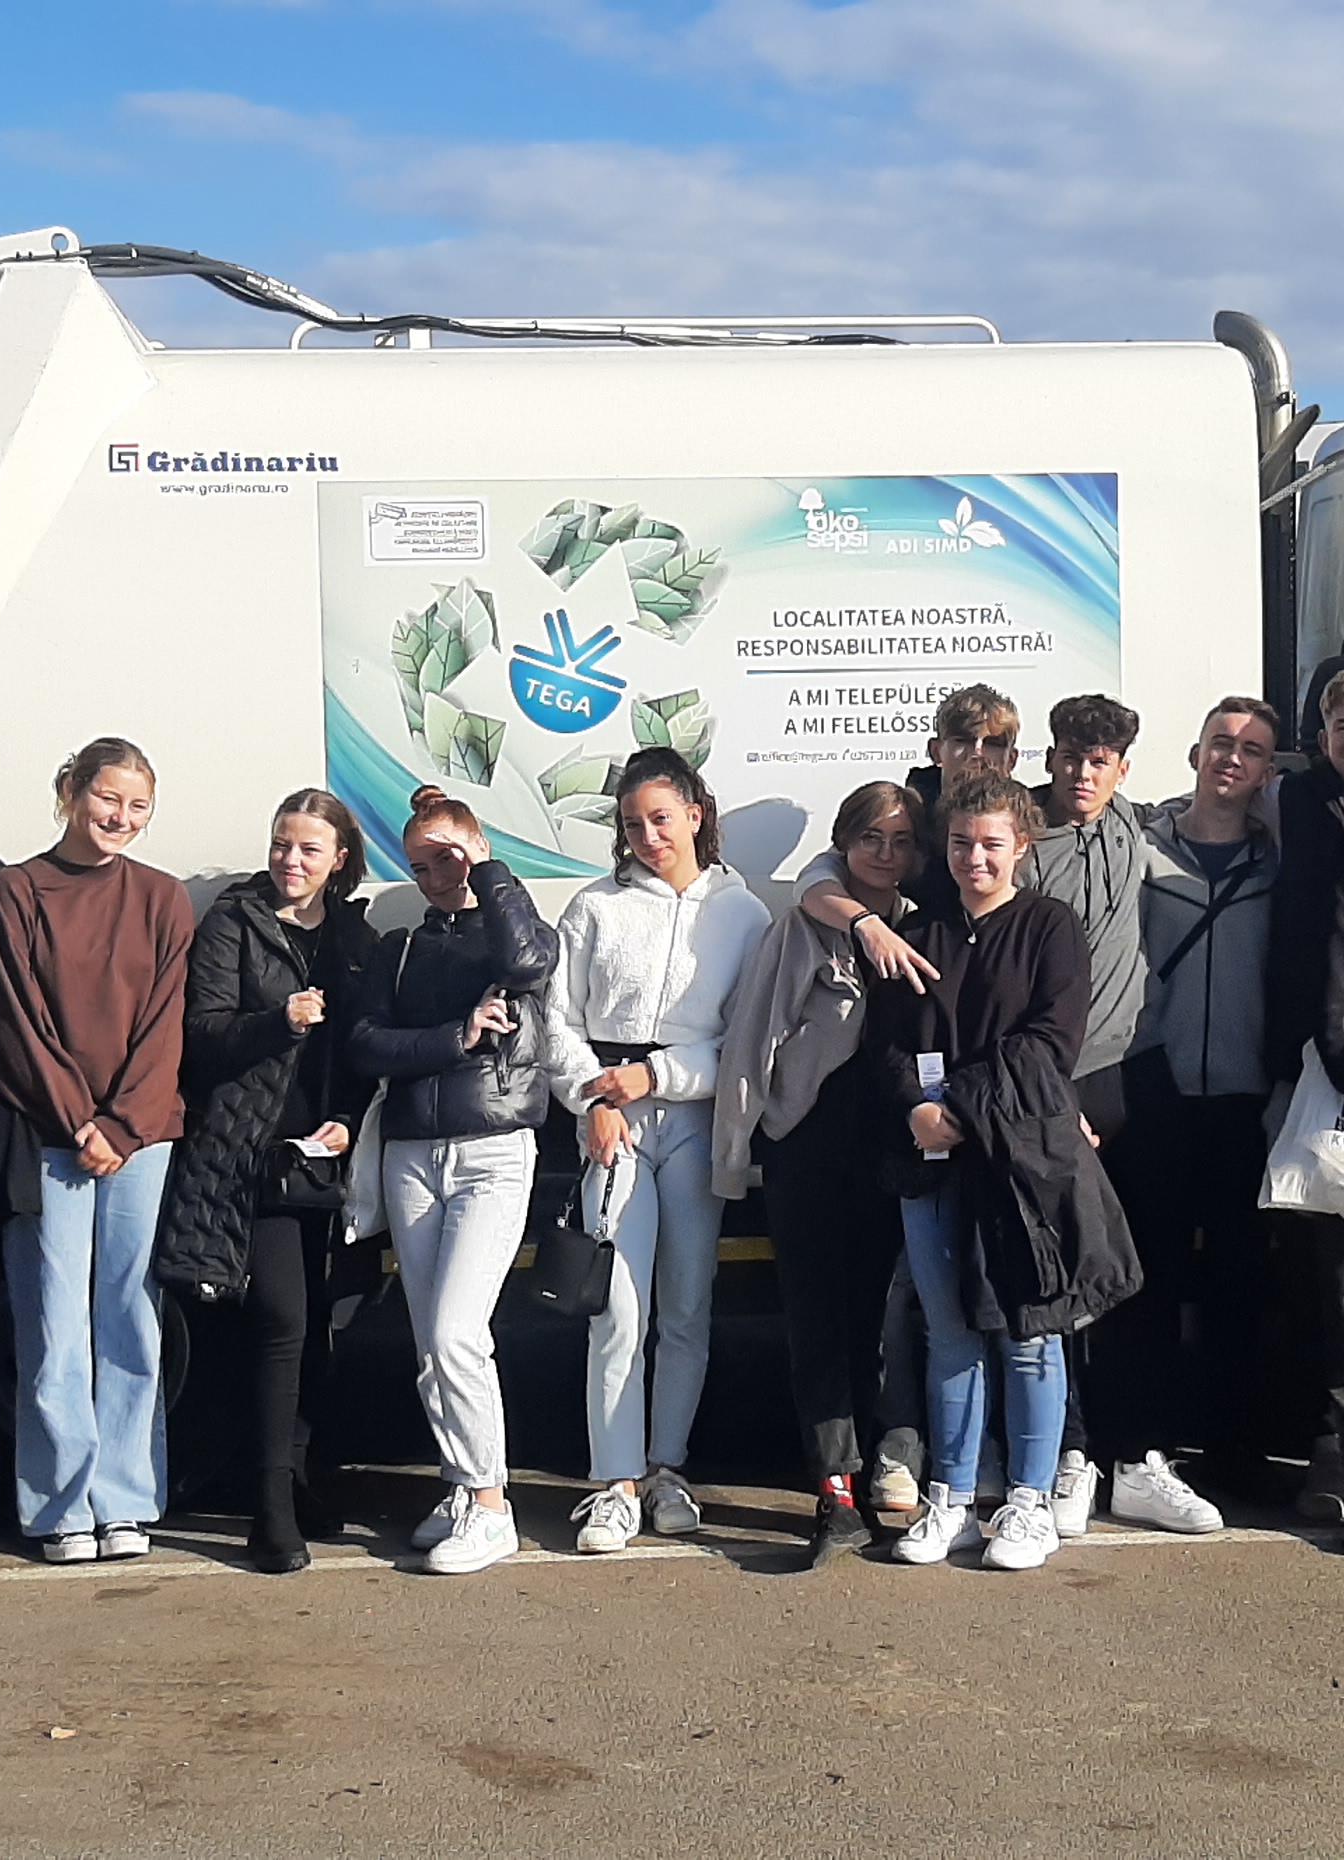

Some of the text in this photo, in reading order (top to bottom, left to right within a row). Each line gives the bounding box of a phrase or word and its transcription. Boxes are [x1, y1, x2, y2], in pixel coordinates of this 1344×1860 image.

[147, 451, 339, 472] Grădinariu
[806, 526, 869, 553] sepsi
[885, 537, 973, 554] ADI SIMD
[773, 602, 1012, 628] LOCALITATEA NOASTRĂ,
[737, 631, 1053, 657] RESPONSABILITATEA NOASTRĂ!
[526, 678, 591, 718] TEGA
[789, 690, 801, 706] A
[807, 688, 829, 706] MI
[784, 718, 797, 735] A
[803, 717, 825, 735] MI
